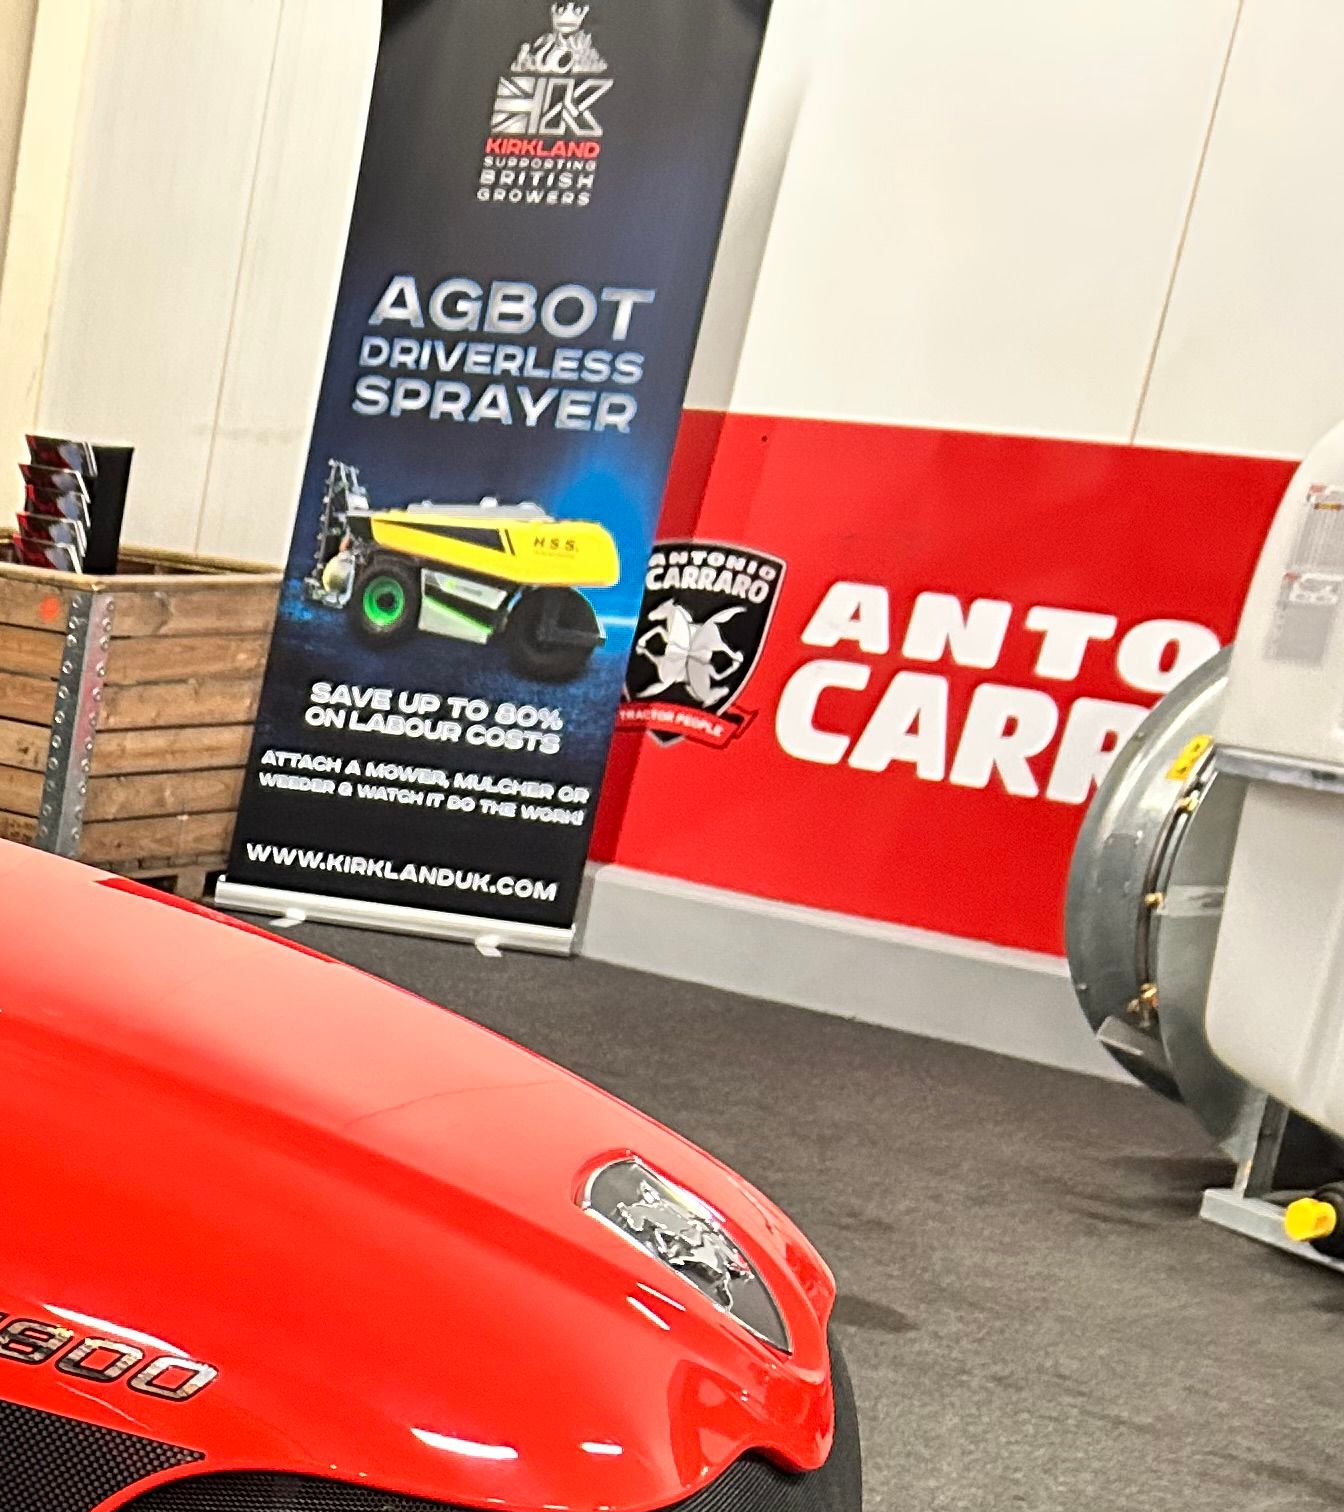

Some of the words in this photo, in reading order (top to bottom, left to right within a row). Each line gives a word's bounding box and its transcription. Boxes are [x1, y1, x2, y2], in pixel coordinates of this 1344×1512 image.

[483, 156, 597, 172] SUPPORTING
[484, 137, 601, 159] KIRKLAND
[476, 187, 592, 207] GROWERS
[479, 168, 595, 189] BRITISH
[367, 274, 657, 342] AGBOT
[358, 335, 646, 385] DRIVERLESS
[351, 374, 639, 434] SPRAYER
[645, 564, 770, 604] CARRARO
[647, 550, 777, 582] ANTONIO
[801, 581, 1220, 695] ANTO
[310, 681, 393, 711] SAVE
[398, 690, 441, 715] UP
[447, 696, 489, 722] TO
[304, 705, 346, 729] ON
[348, 709, 462, 743] LABOUR
[465, 723, 561, 755] COSTS
[258, 771, 336, 795] WEEDER
[357, 784, 423, 806] WATCH
[425, 792, 445, 808] IT
[446, 795, 476, 812] DO
[479, 798, 517, 818] THE
[260, 749, 341, 774] ATTACH
[344, 761, 361, 776] A
[365, 761, 451, 789] MOWER,
[453, 772, 555, 800] MULCHER
[557, 786, 591, 804] OR
[245, 842, 559, 902] WWW.KIRKLANDUK.COM
